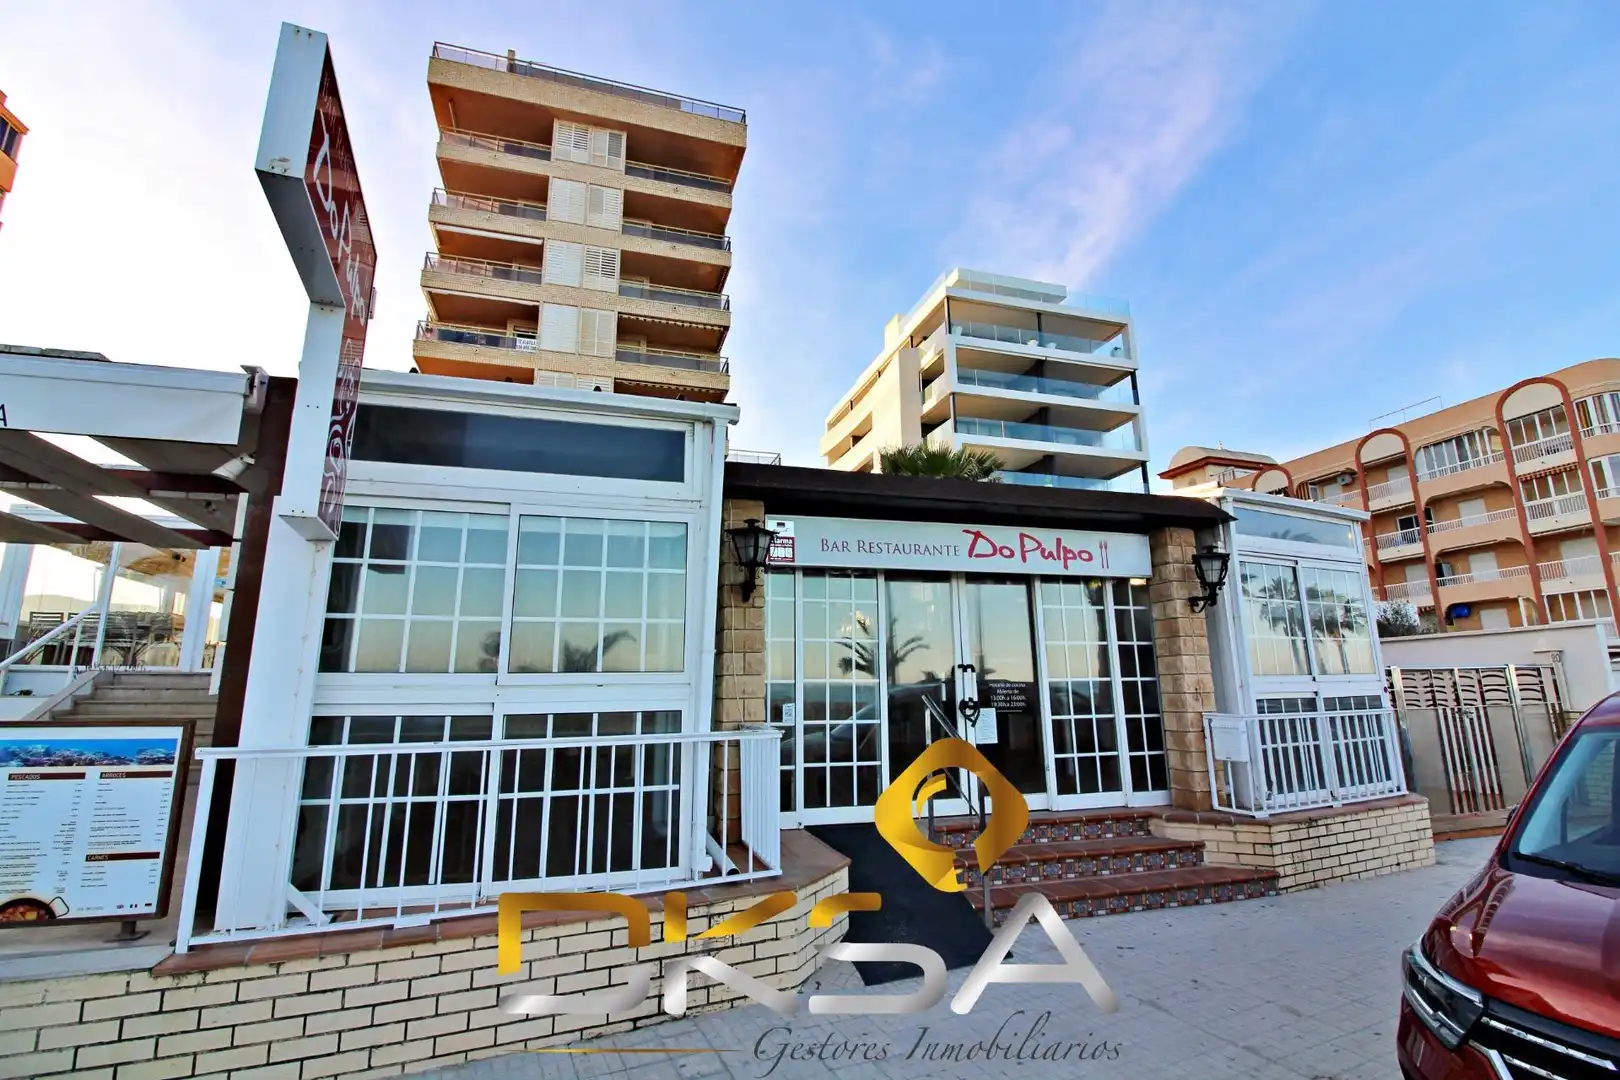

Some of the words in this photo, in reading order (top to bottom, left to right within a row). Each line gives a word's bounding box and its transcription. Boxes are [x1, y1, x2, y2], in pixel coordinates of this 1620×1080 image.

[821, 538, 852, 552] BAR
[857, 539, 960, 556] RESTAURANTE
[962, 529, 1015, 558] Do
[1019, 532, 1093, 571] Pulpo
